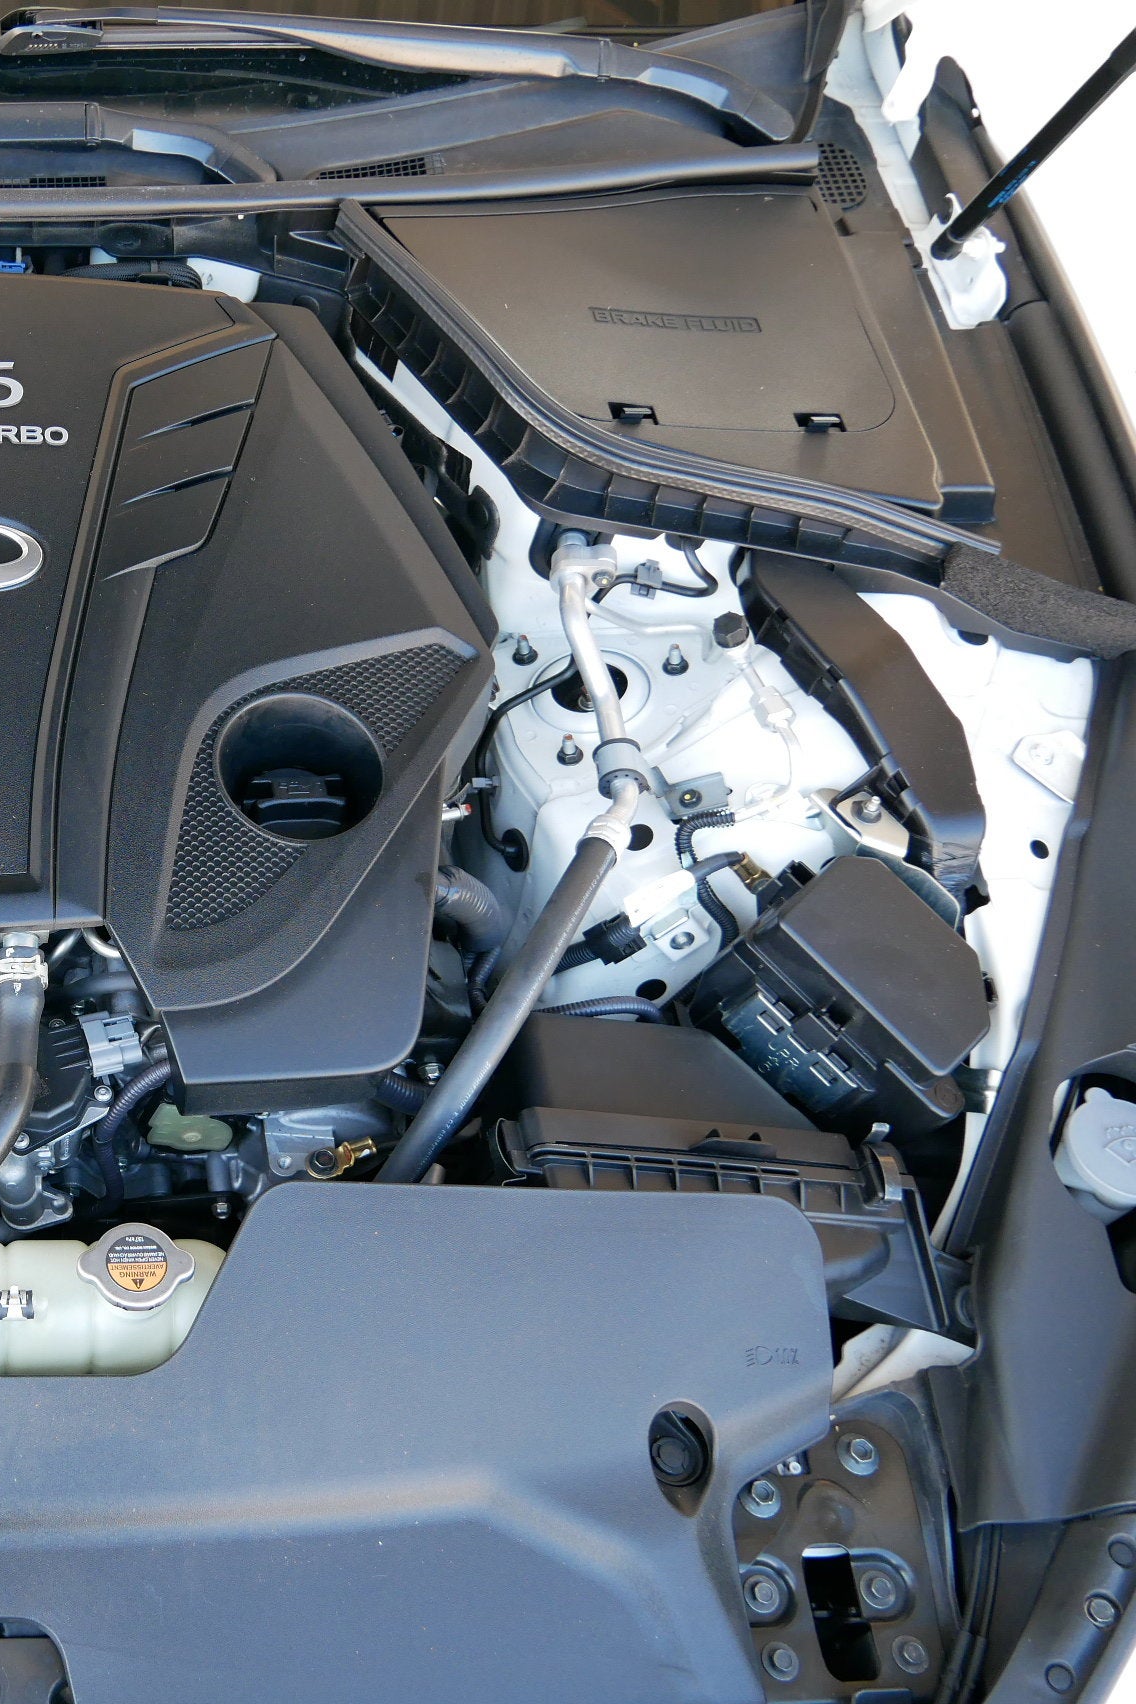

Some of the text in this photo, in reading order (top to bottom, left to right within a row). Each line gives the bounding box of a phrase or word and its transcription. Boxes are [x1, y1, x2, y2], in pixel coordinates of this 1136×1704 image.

[592, 309, 760, 333] BRAKE FLUID
[110, 1263, 164, 1271] AVERTISSEMENT
[119, 1270, 157, 1278] WARNING
